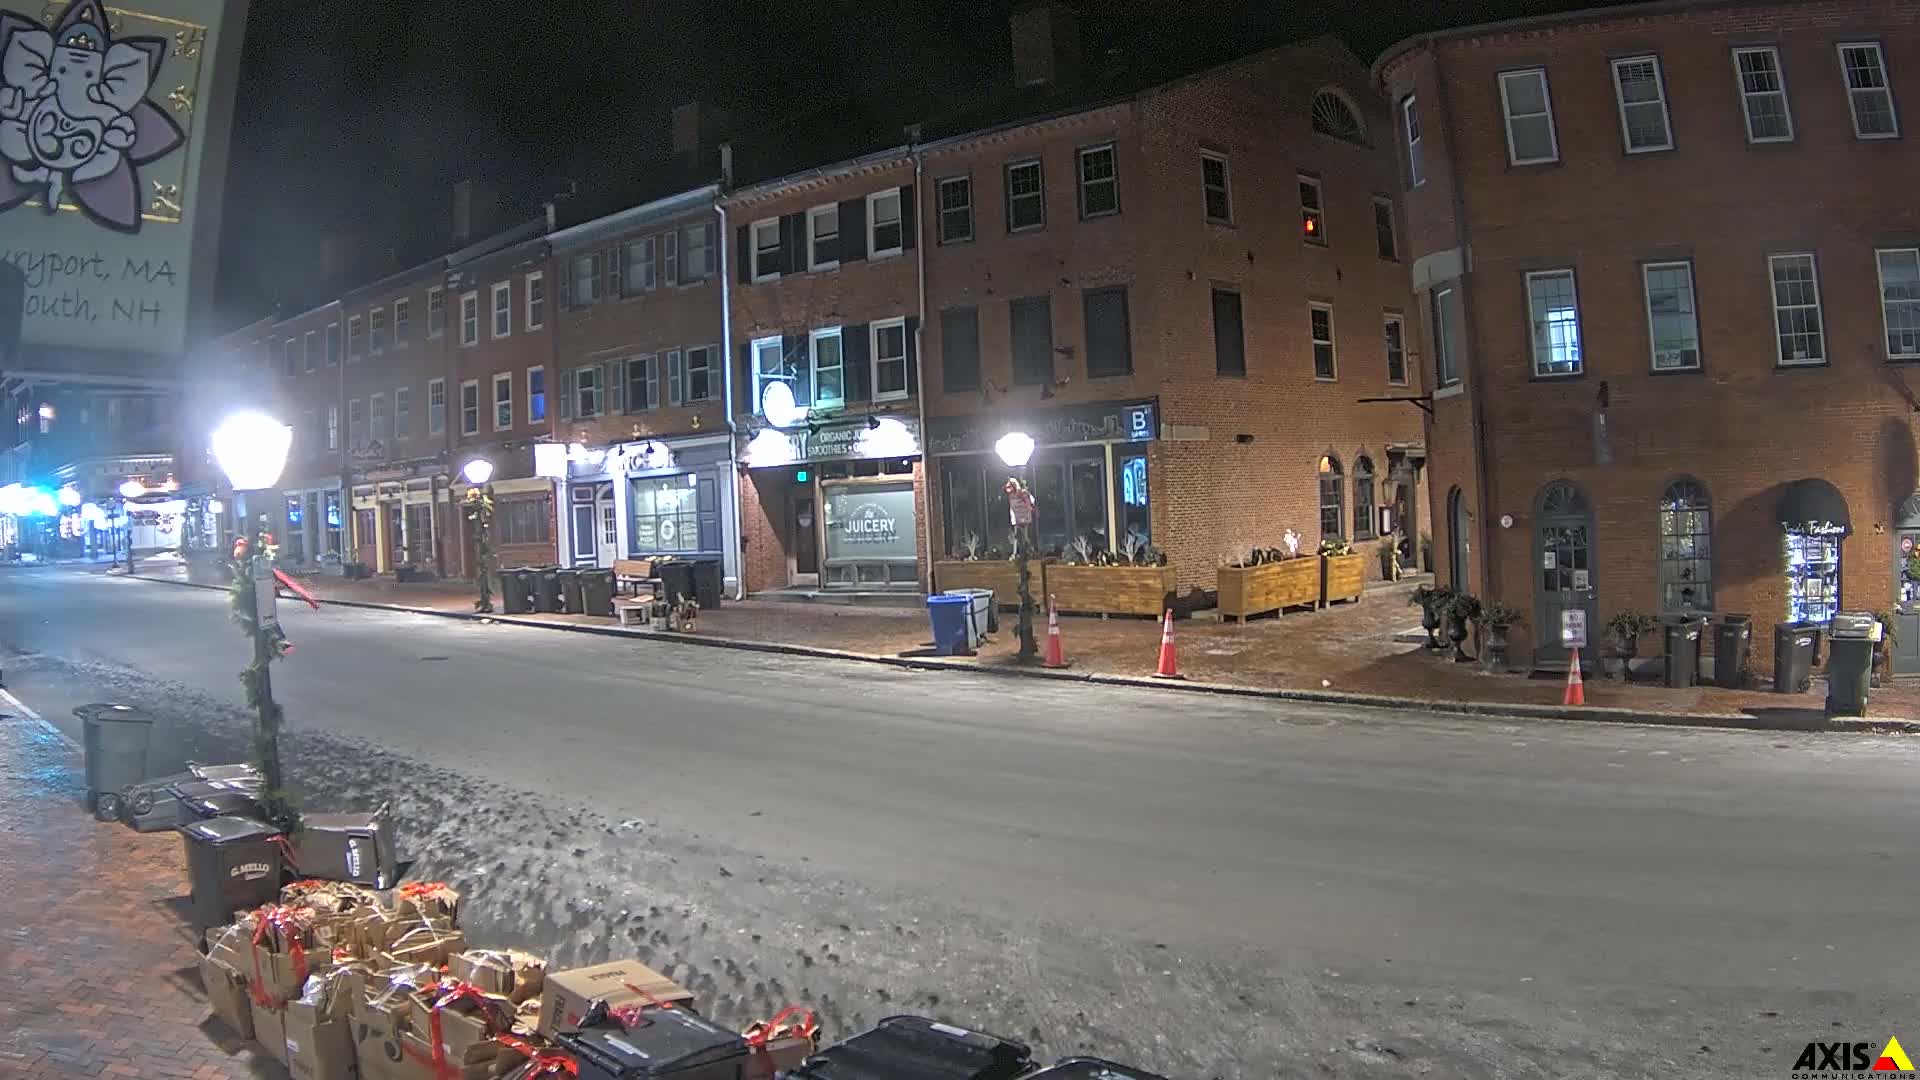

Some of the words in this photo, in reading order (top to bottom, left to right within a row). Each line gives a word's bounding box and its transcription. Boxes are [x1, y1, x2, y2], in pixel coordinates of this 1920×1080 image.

[121, 257, 177, 287] MA
[25, 288, 97, 325] outh,
[112, 297, 161, 327] NH
[819, 429, 852, 443] ORGANIC
[807, 443, 848, 457] SMOOTHIES
[845, 517, 895, 533] JUICERY
